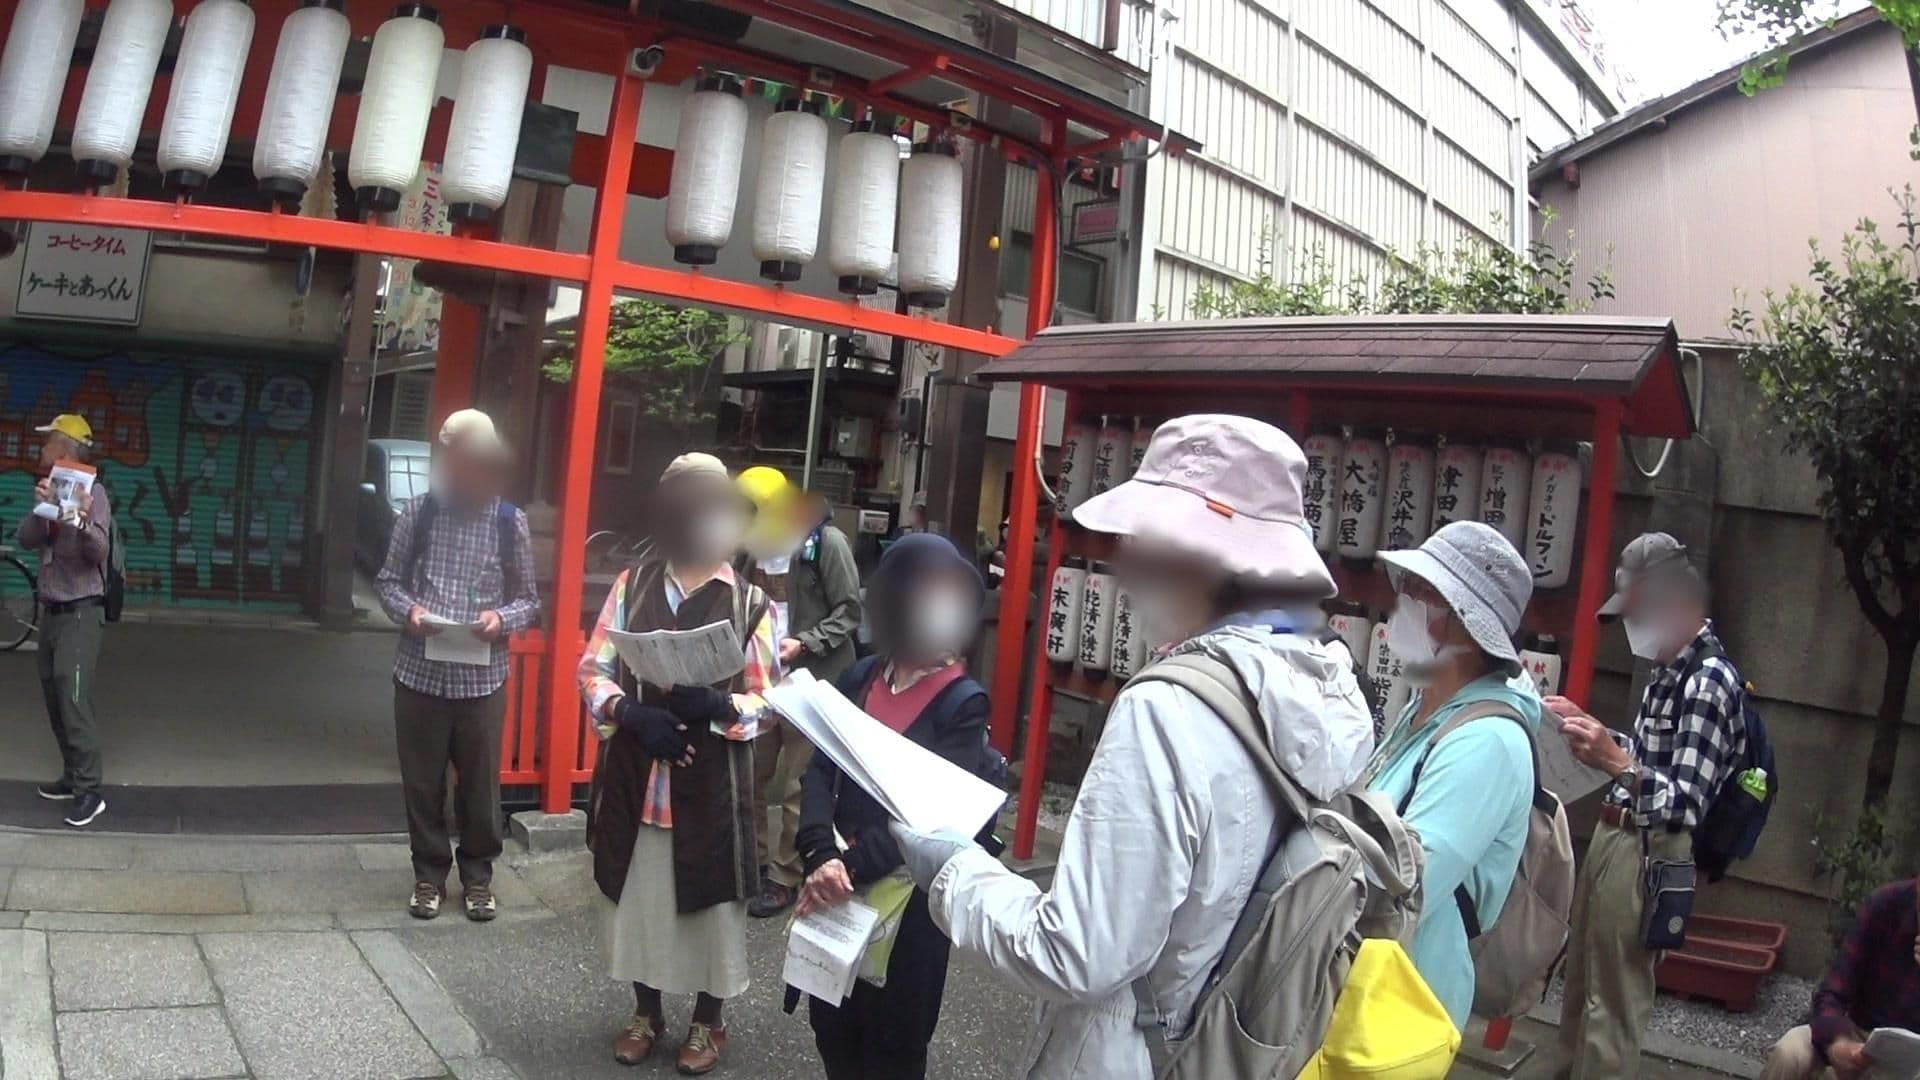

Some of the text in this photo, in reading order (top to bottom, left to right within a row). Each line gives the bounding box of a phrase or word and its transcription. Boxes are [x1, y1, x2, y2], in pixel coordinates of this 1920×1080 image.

[47, 234, 127, 256] コーヒータイム
[26, 271, 133, 301] ケーキとあっくん
[1339, 459, 1367, 547] 大橋屋
